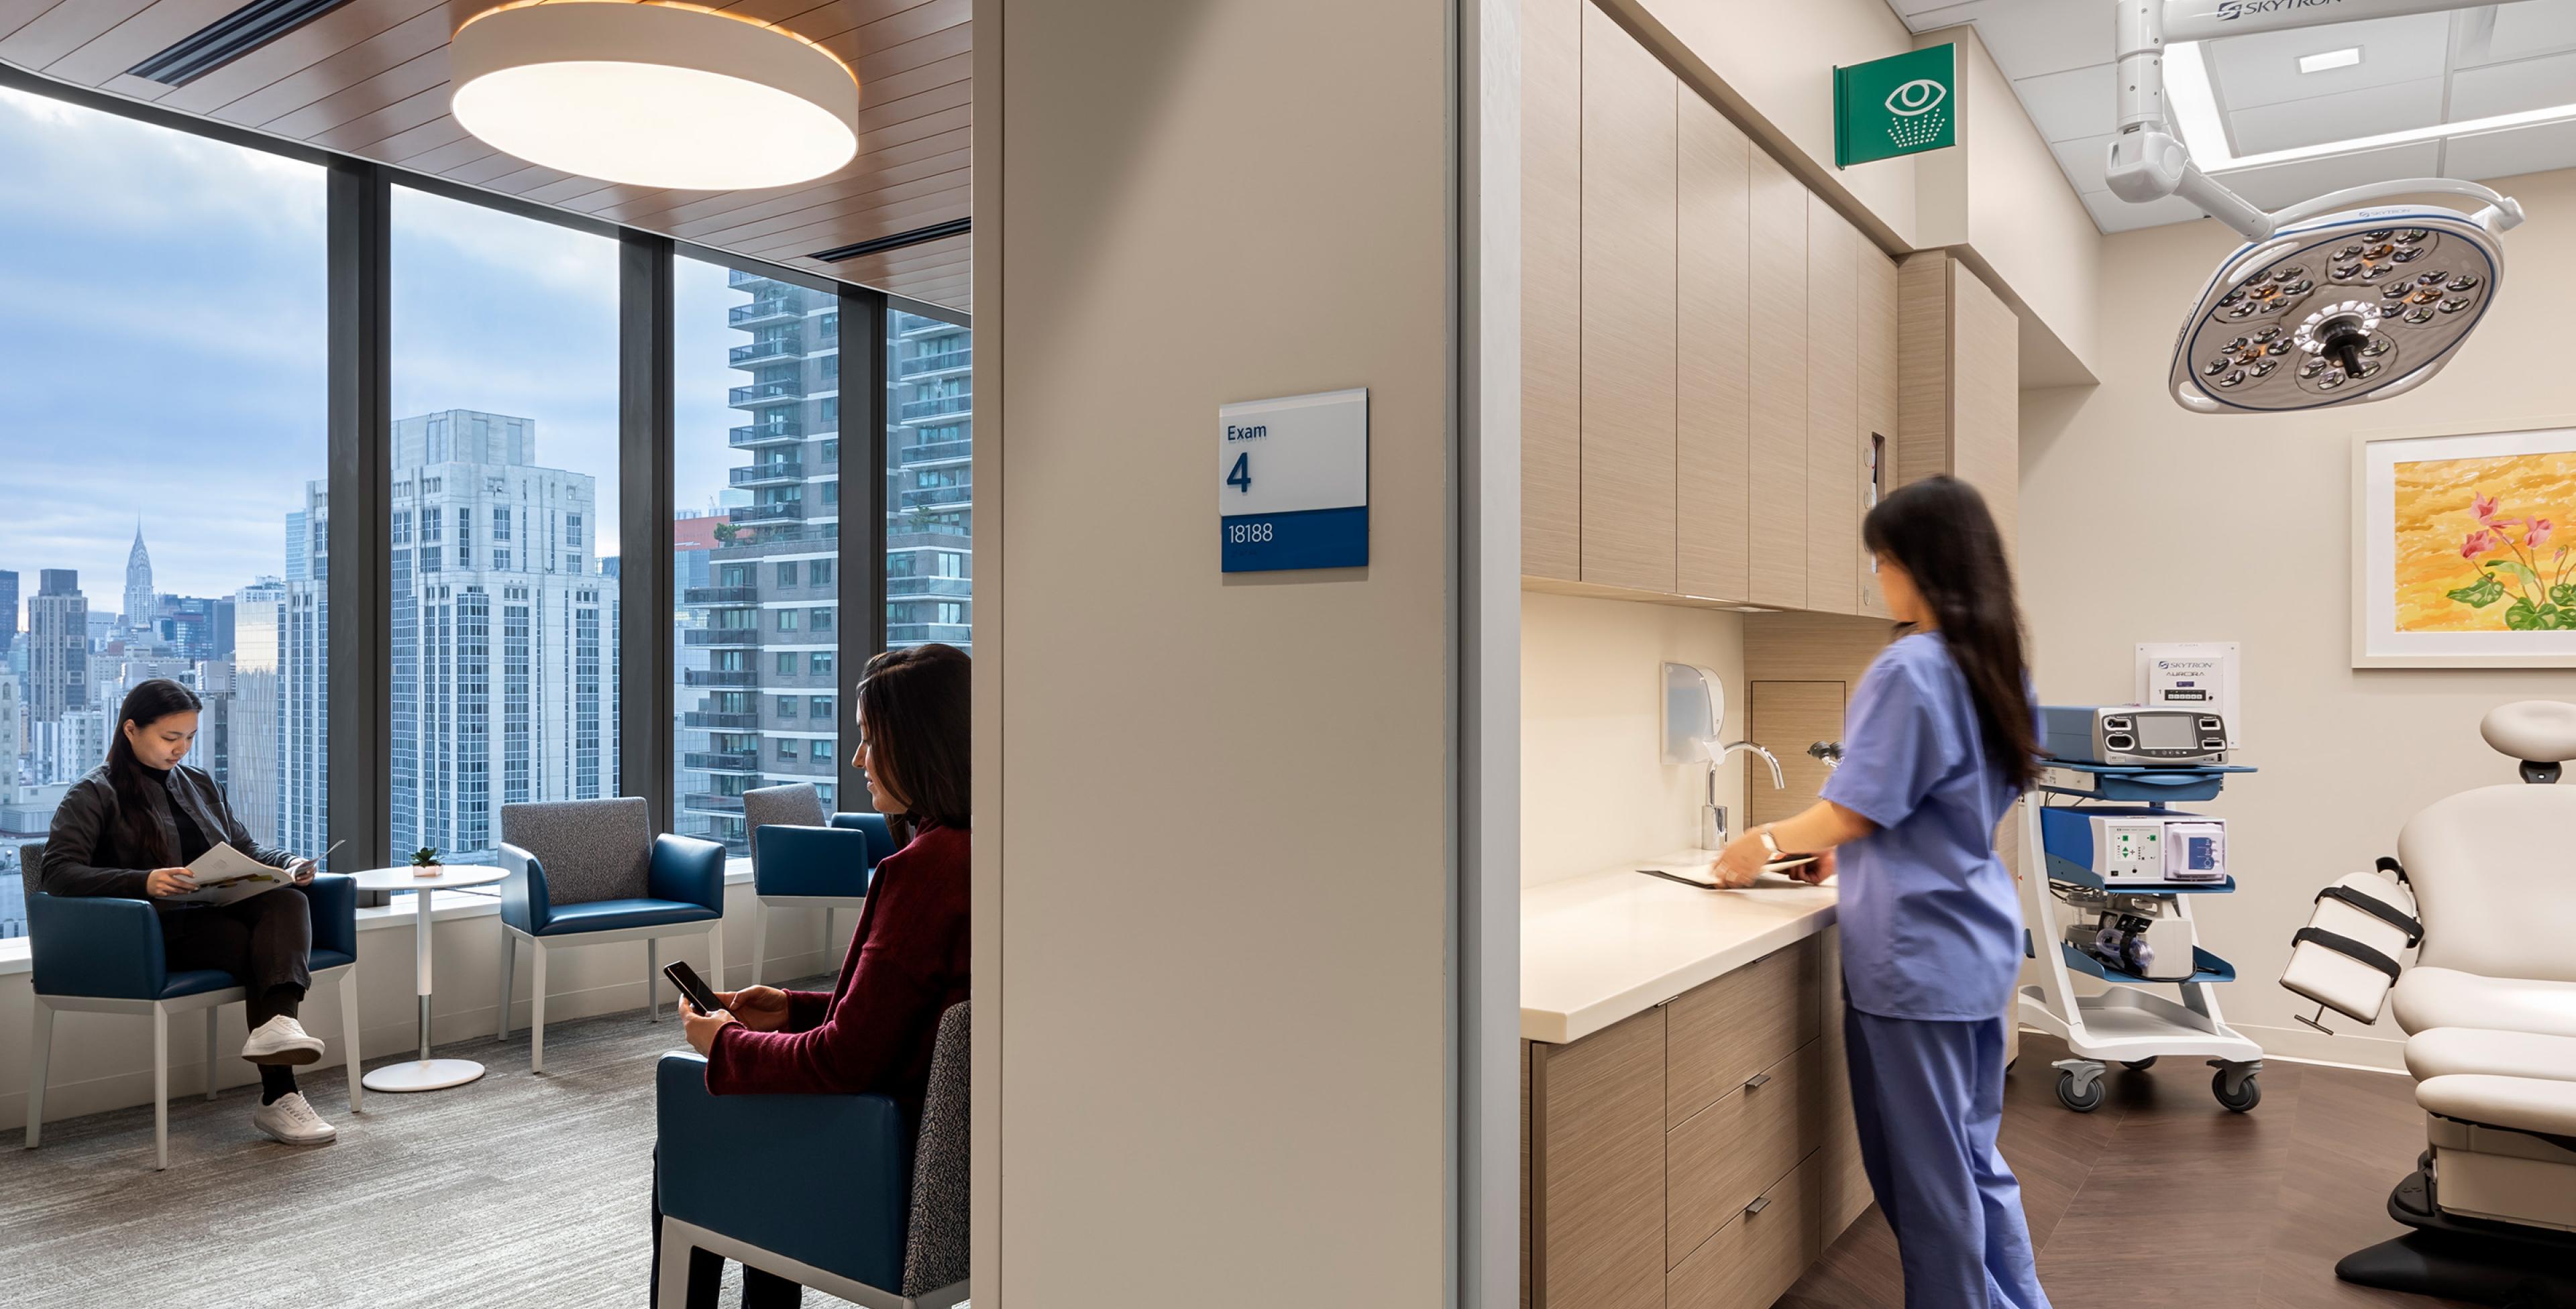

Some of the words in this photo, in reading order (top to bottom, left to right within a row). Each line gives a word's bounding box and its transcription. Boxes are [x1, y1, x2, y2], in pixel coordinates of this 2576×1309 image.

[2243, 0, 2341, 15] SKYTR
[1227, 424, 1267, 441] Exam
[1226, 452, 1251, 493] 4
[1228, 522, 1273, 543] 18188
